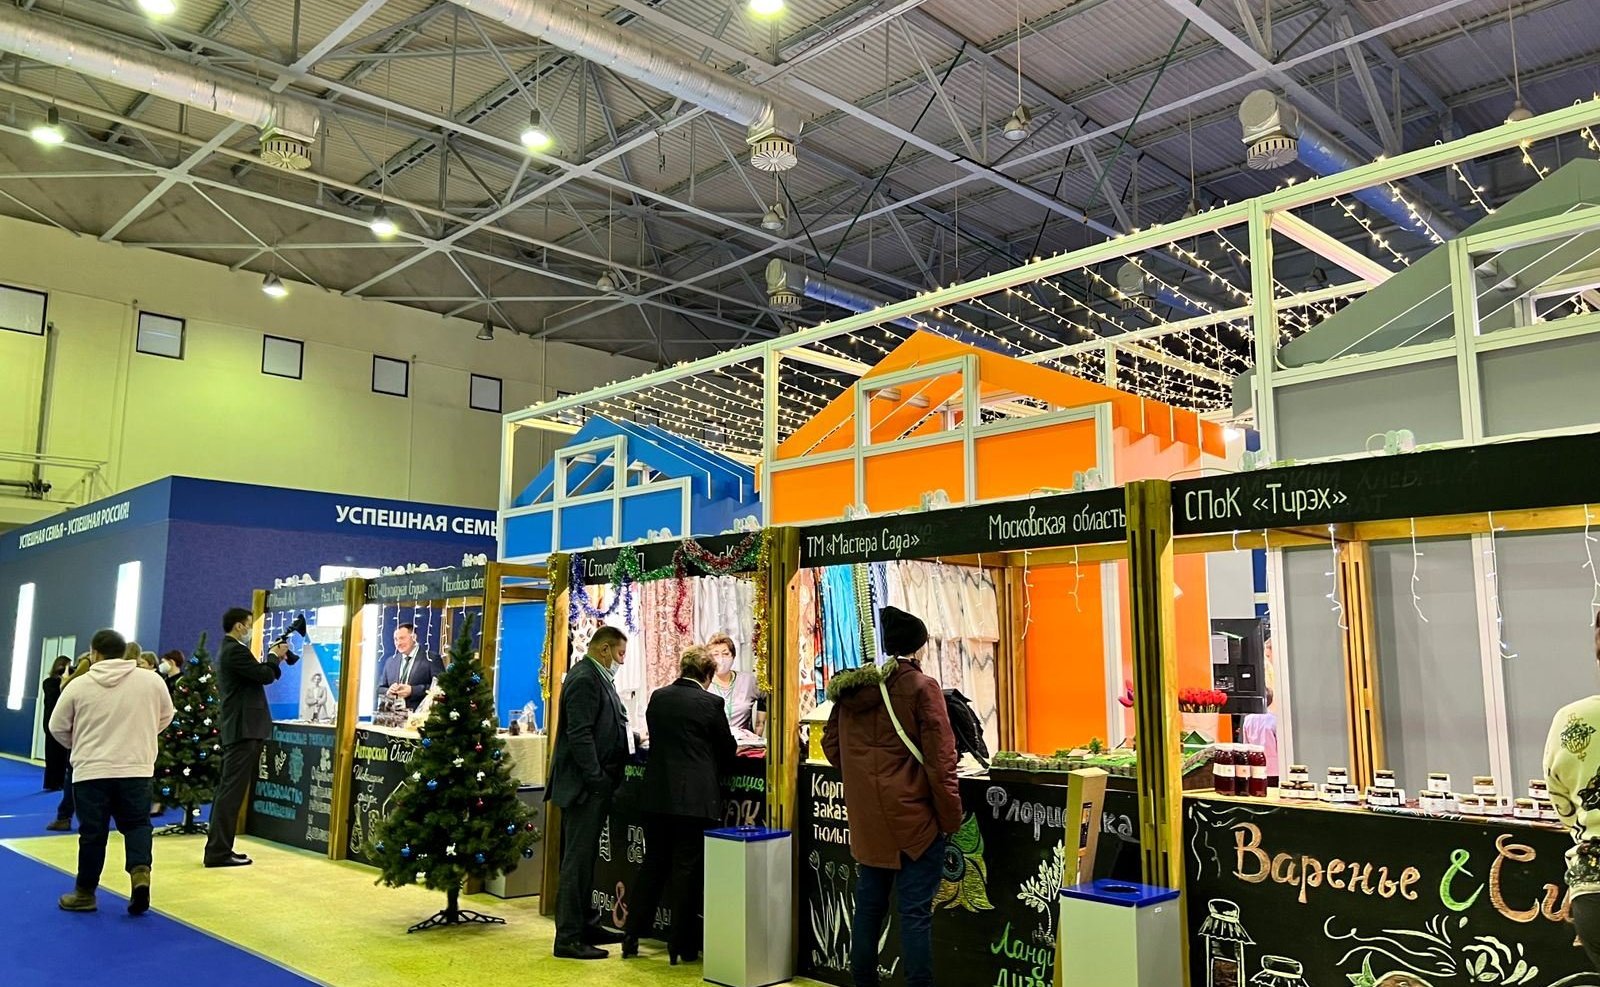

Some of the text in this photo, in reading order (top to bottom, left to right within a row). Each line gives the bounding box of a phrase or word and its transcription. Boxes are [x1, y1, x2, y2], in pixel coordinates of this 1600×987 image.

[336, 505, 447, 532] УСПЕШНАЯ
[1185, 487, 1242, 521] СПоК
[1252, 484, 1348, 521] «Тирэх»
[19, 528, 46, 549] УСПЕШНАЯ
[45, 522, 64, 541] СЕМЬЯ
[67, 511, 101, 535] УСПЕШНАЯ
[100, 501, 130, 526] РОССИЯ!
[989, 504, 1126, 541] Московская область
[807, 535, 825, 558] ТМ
[825, 533, 878, 558] «Мастера
[882, 528, 920, 557] Сада»
[811, 773, 844, 809] Корп
[813, 801, 849, 821] заказ
[1231, 822, 1421, 903] Варенье
[1489, 833, 1576, 924] Си
